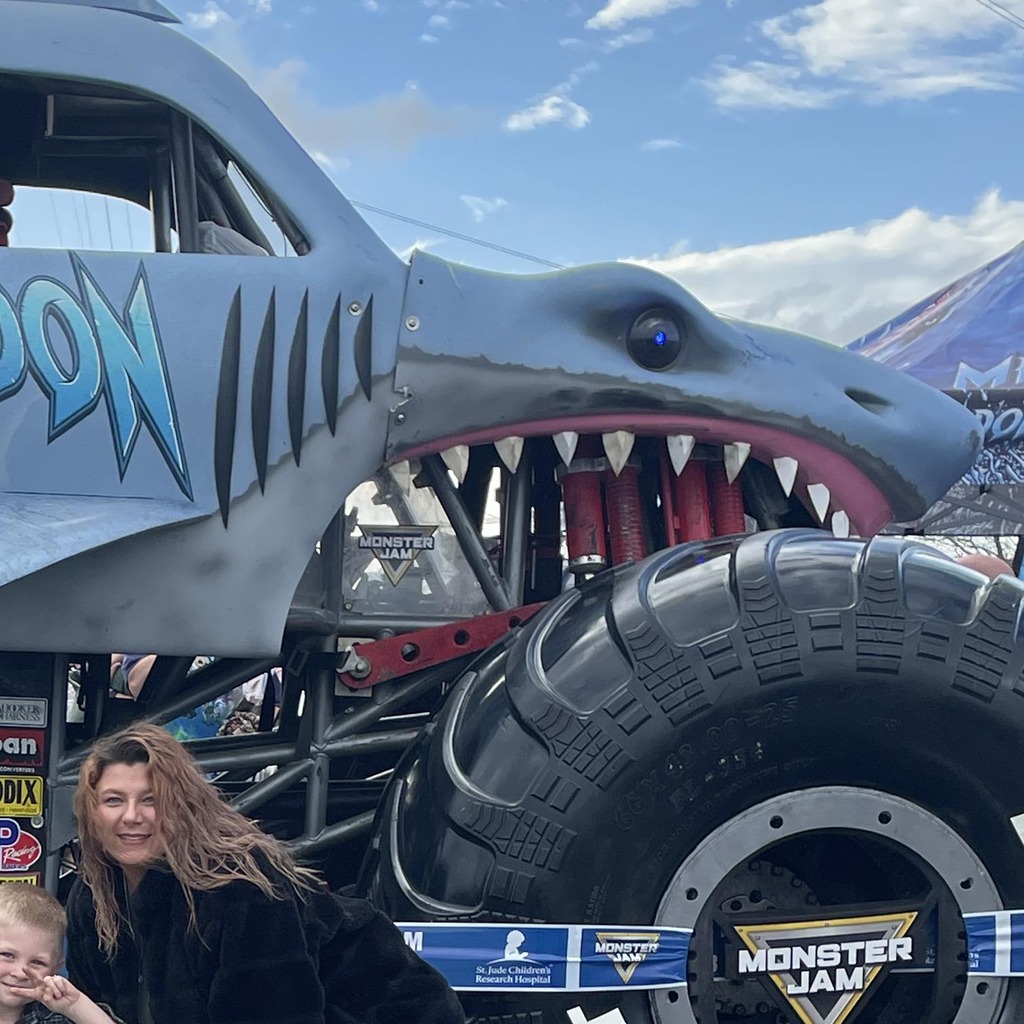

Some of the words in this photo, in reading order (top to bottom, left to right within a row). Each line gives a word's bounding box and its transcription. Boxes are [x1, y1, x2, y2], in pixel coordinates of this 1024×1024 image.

[359, 536, 434, 550] MONSTER
[380, 548, 413, 560] JAM
[3, 845, 39, 864] Racing
[595, 942, 660, 953] MONSTER
[613, 952, 643, 962] JAM
[738, 937, 912, 973] MONSTER
[476, 966, 487, 975] St.
[487, 966, 507, 976] Jude
[508, 965, 551, 975] Children's
[476, 975, 513, 983] Research
[515, 975, 551, 985] Hospital
[787, 966, 864, 995] JAM
